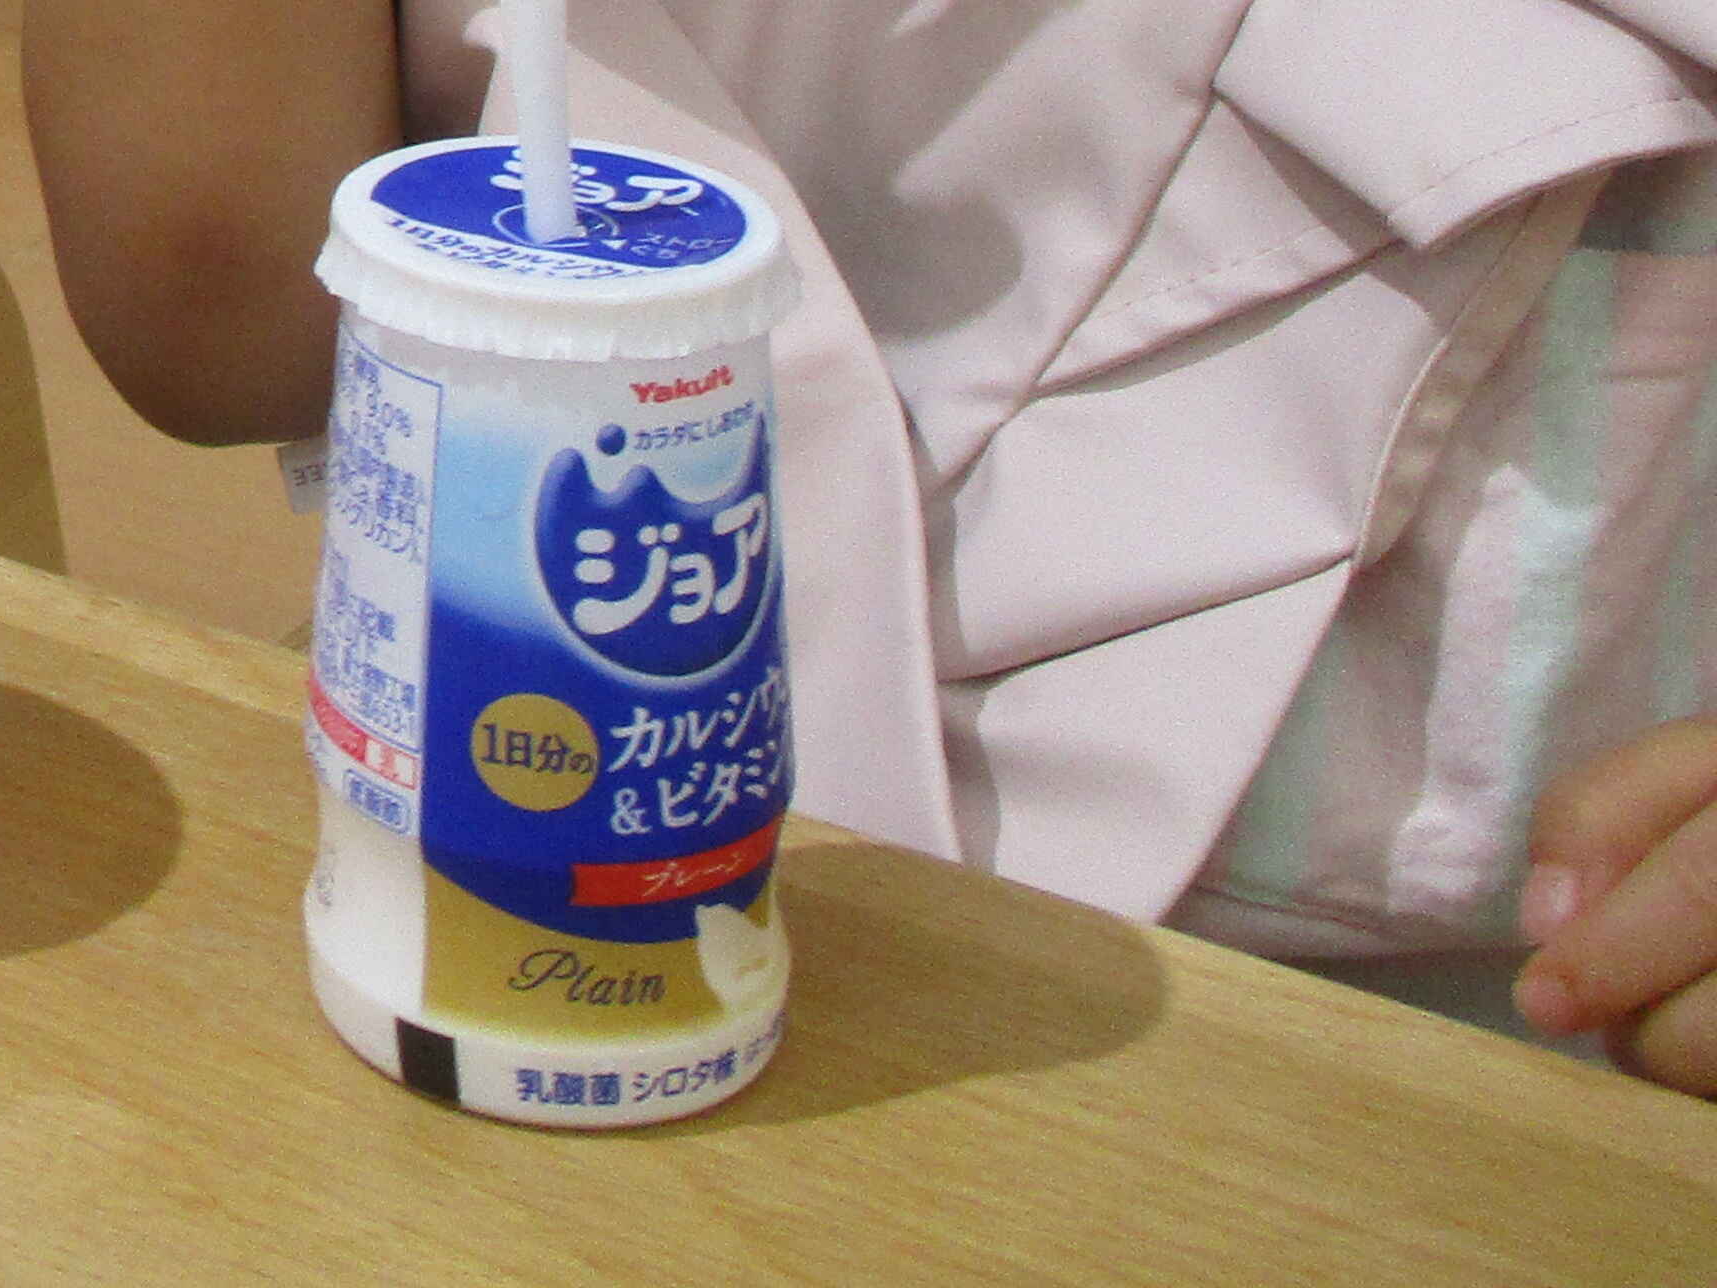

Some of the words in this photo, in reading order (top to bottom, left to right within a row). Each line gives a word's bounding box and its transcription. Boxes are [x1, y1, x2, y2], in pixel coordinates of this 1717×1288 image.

[628, 364, 734, 404] Yakult
[572, 491, 768, 637] ジョア
[479, 723, 596, 775] 1日分の
[507, 947, 668, 1007] Plain
[515, 1067, 622, 1107] 乳酸菌
